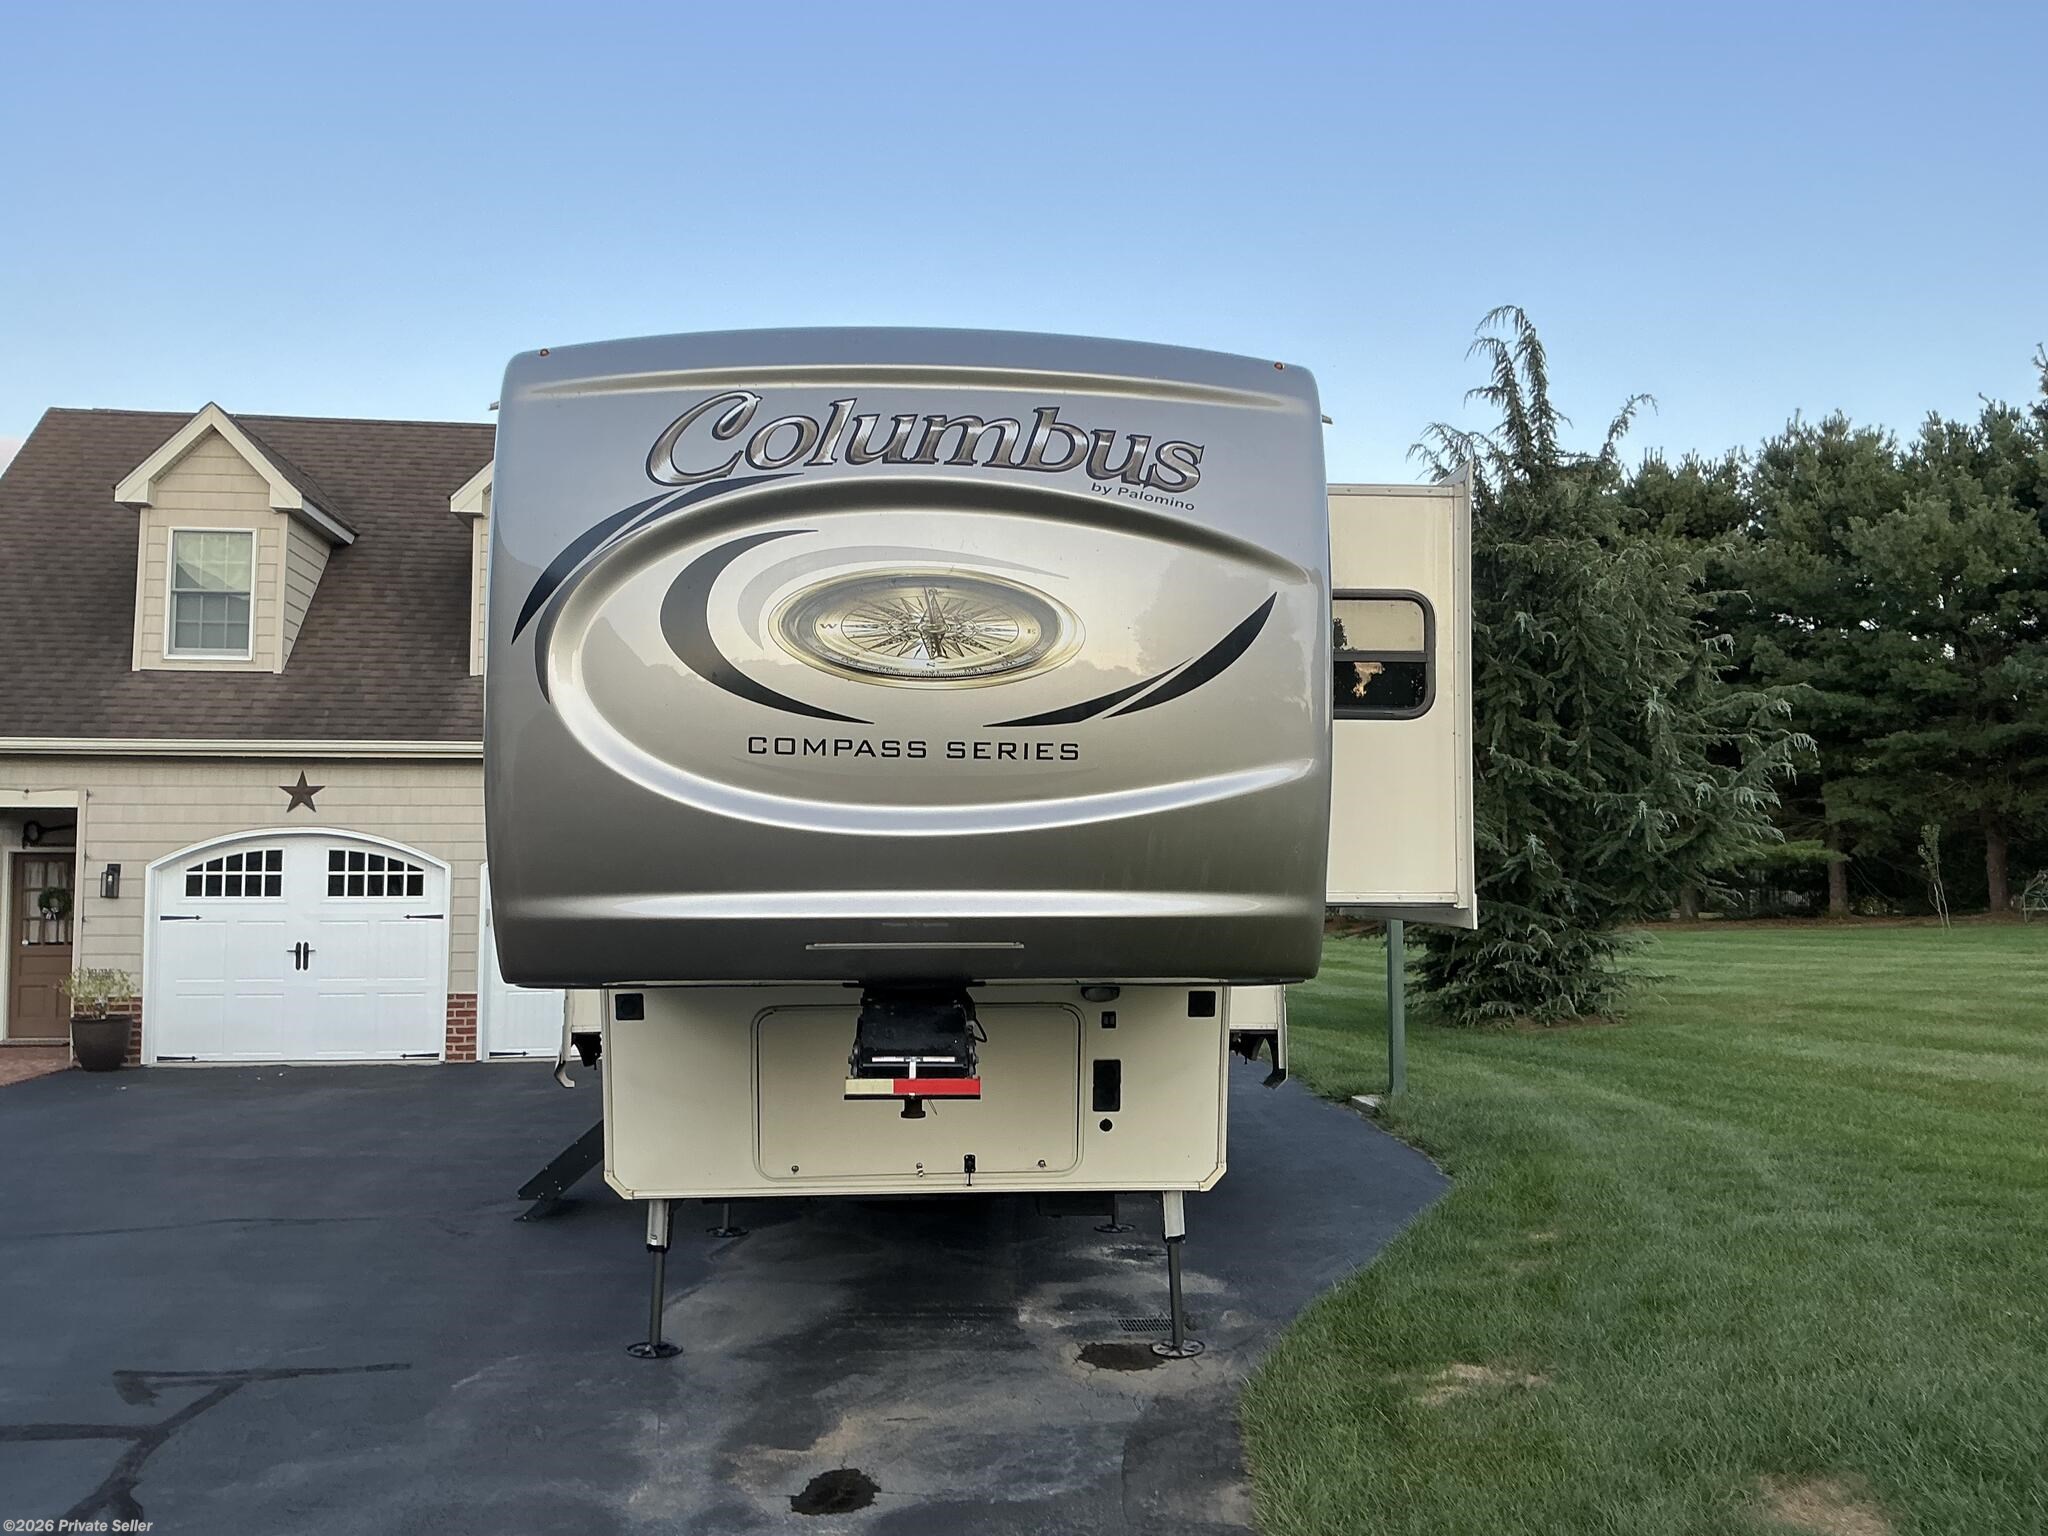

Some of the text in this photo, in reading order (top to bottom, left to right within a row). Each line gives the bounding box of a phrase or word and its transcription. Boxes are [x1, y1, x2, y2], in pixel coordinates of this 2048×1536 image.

[645, 390, 1205, 493] Columbus
[1091, 482, 1195, 511] by Palomino
[747, 736, 1080, 761] COMPASS SERIES
